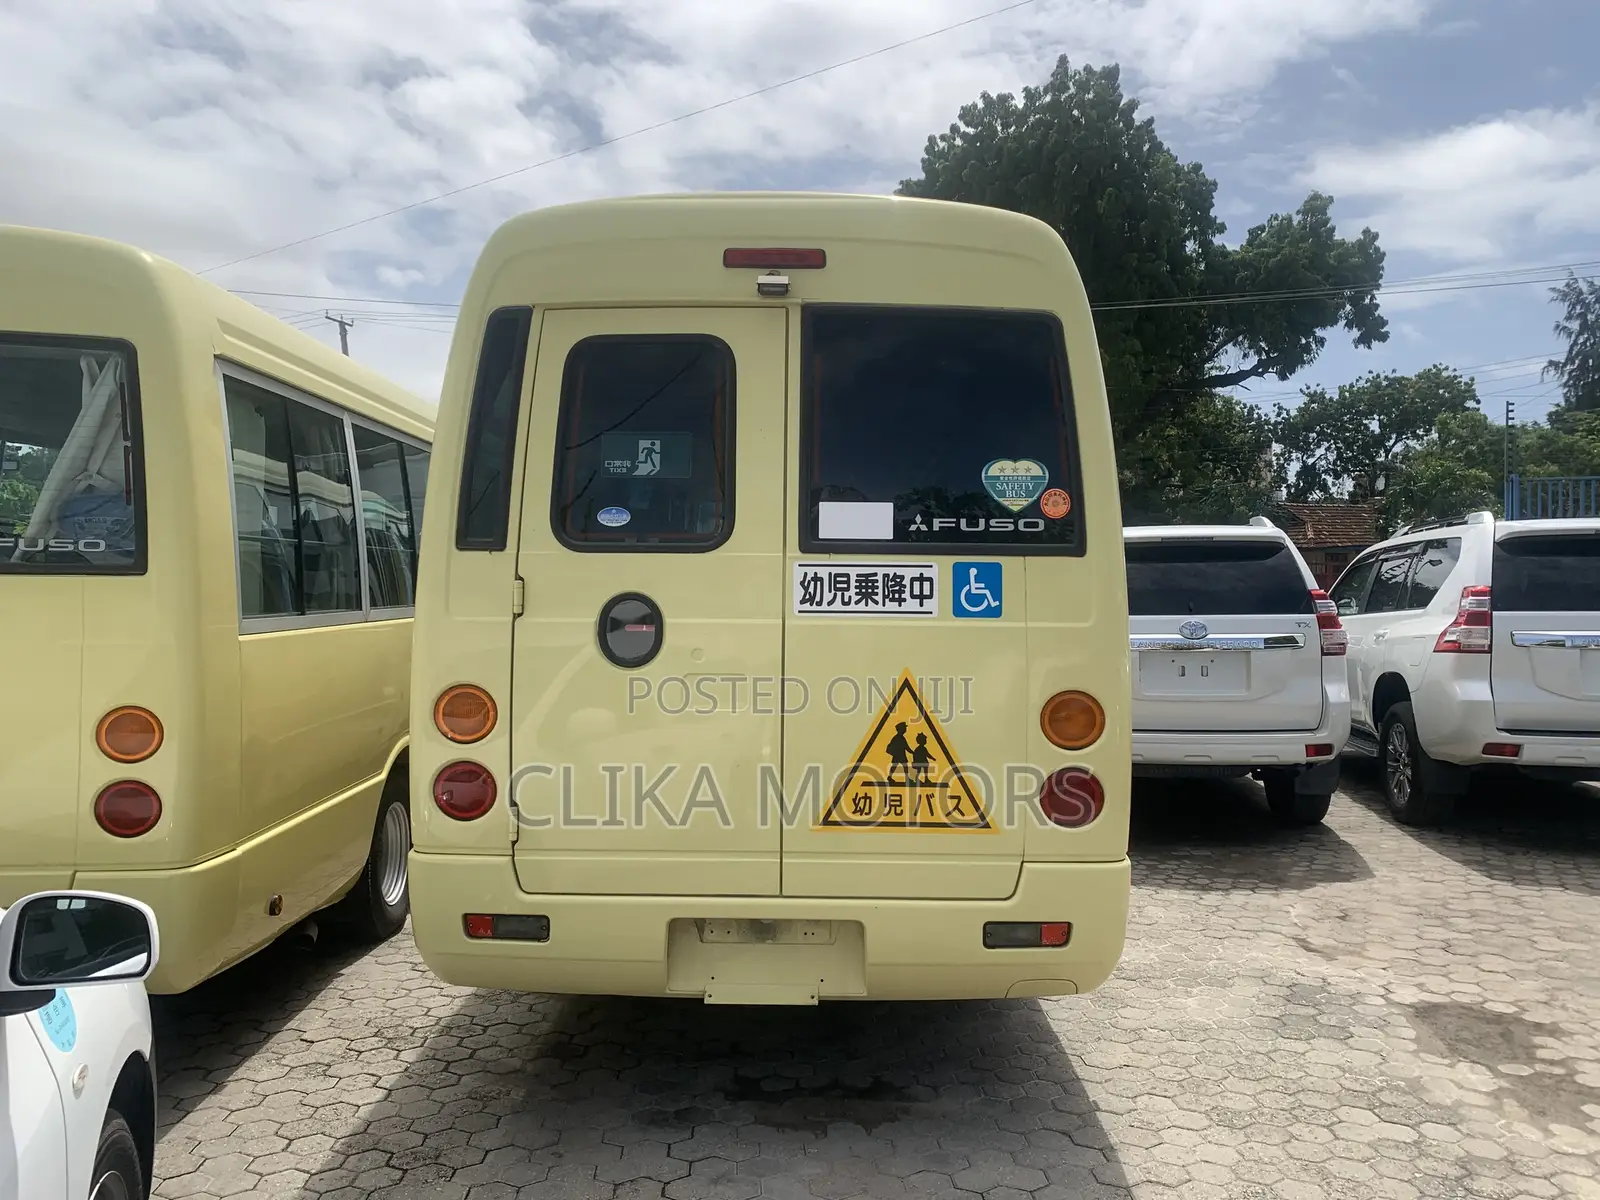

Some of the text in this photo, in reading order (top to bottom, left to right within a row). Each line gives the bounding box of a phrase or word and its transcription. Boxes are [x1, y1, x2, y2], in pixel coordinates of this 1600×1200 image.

[996, 482, 1035, 491] SAFETY
[1006, 490, 1026, 498] BUS
[932, 519, 1045, 532] FUSO
[798, 570, 935, 608] 幼児乗降中
[1295, 621, 1312, 629] TX
[852, 792, 966, 818] 幼児バス
